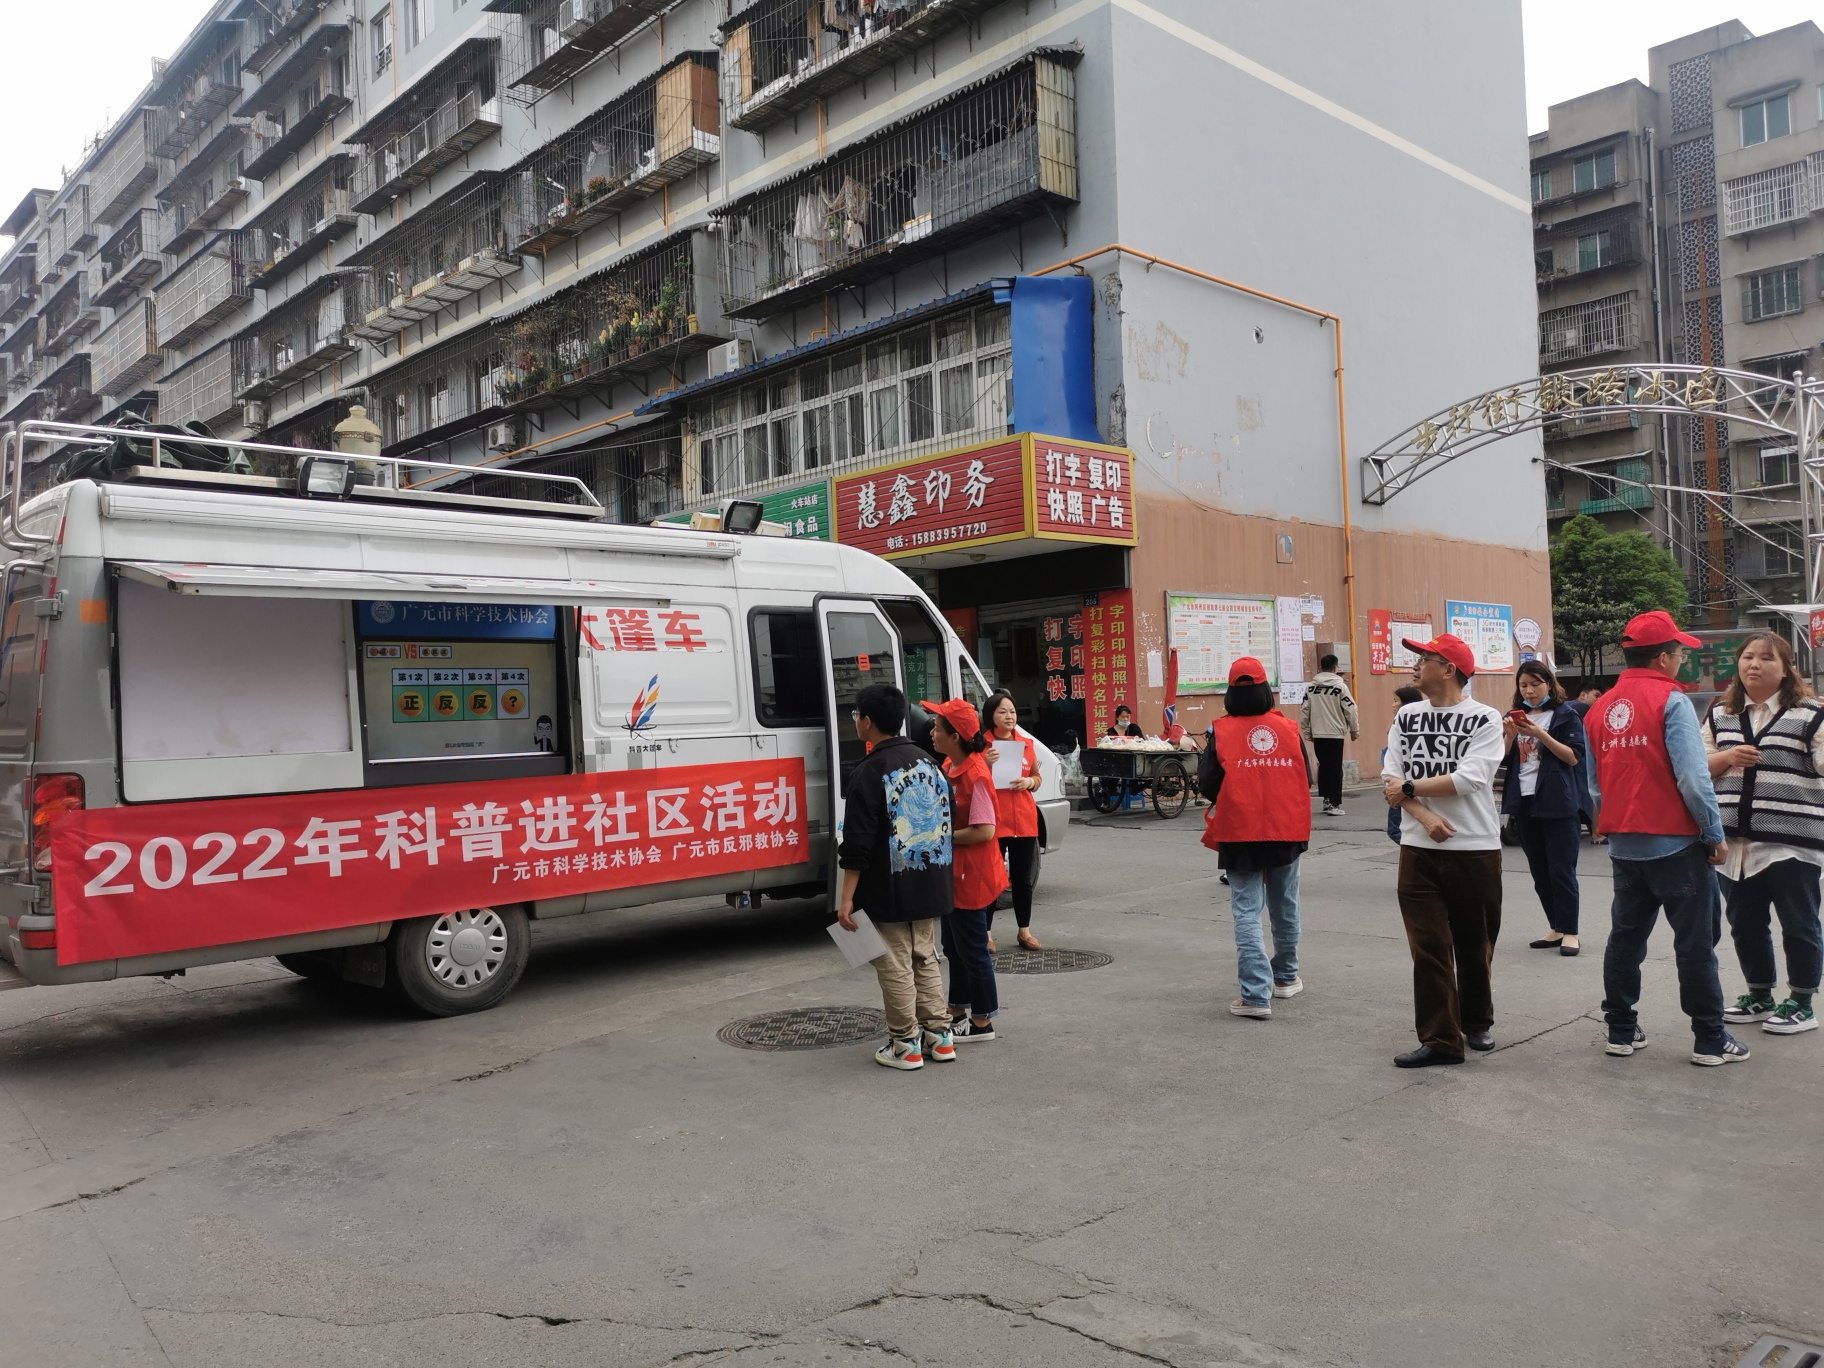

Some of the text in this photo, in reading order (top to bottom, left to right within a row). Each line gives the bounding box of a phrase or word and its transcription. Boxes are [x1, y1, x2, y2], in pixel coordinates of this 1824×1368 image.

[1045, 449, 1122, 492] 打字 复印
[791, 494, 818, 509] 火车站店
[857, 459, 995, 530] 慧鑫印务
[1047, 487, 1124, 528] 快照 广告
[402, 605, 549, 625] 广元市科学技术协会
[1044, 614, 1084, 642] 打字
[404, 644, 418, 659] VS
[1046, 645, 1085, 671] 复印
[398, 672, 423, 682] 第1次
[433, 672, 459, 682] 第2次
[468, 672, 493, 682] 第3次
[501, 672, 525, 681] 第4次
[1047, 674, 1087, 701] 快照
[404, 695, 419, 710] 正
[438, 695, 453, 710] 反
[472, 695, 487, 709] 反
[1237, 758, 1293, 768] 广元市科普志愿者
[84, 777, 798, 897] 2022年科普进社区活动
[491, 828, 800, 885] 广元市科学技术协会 广元市反邪教协会
